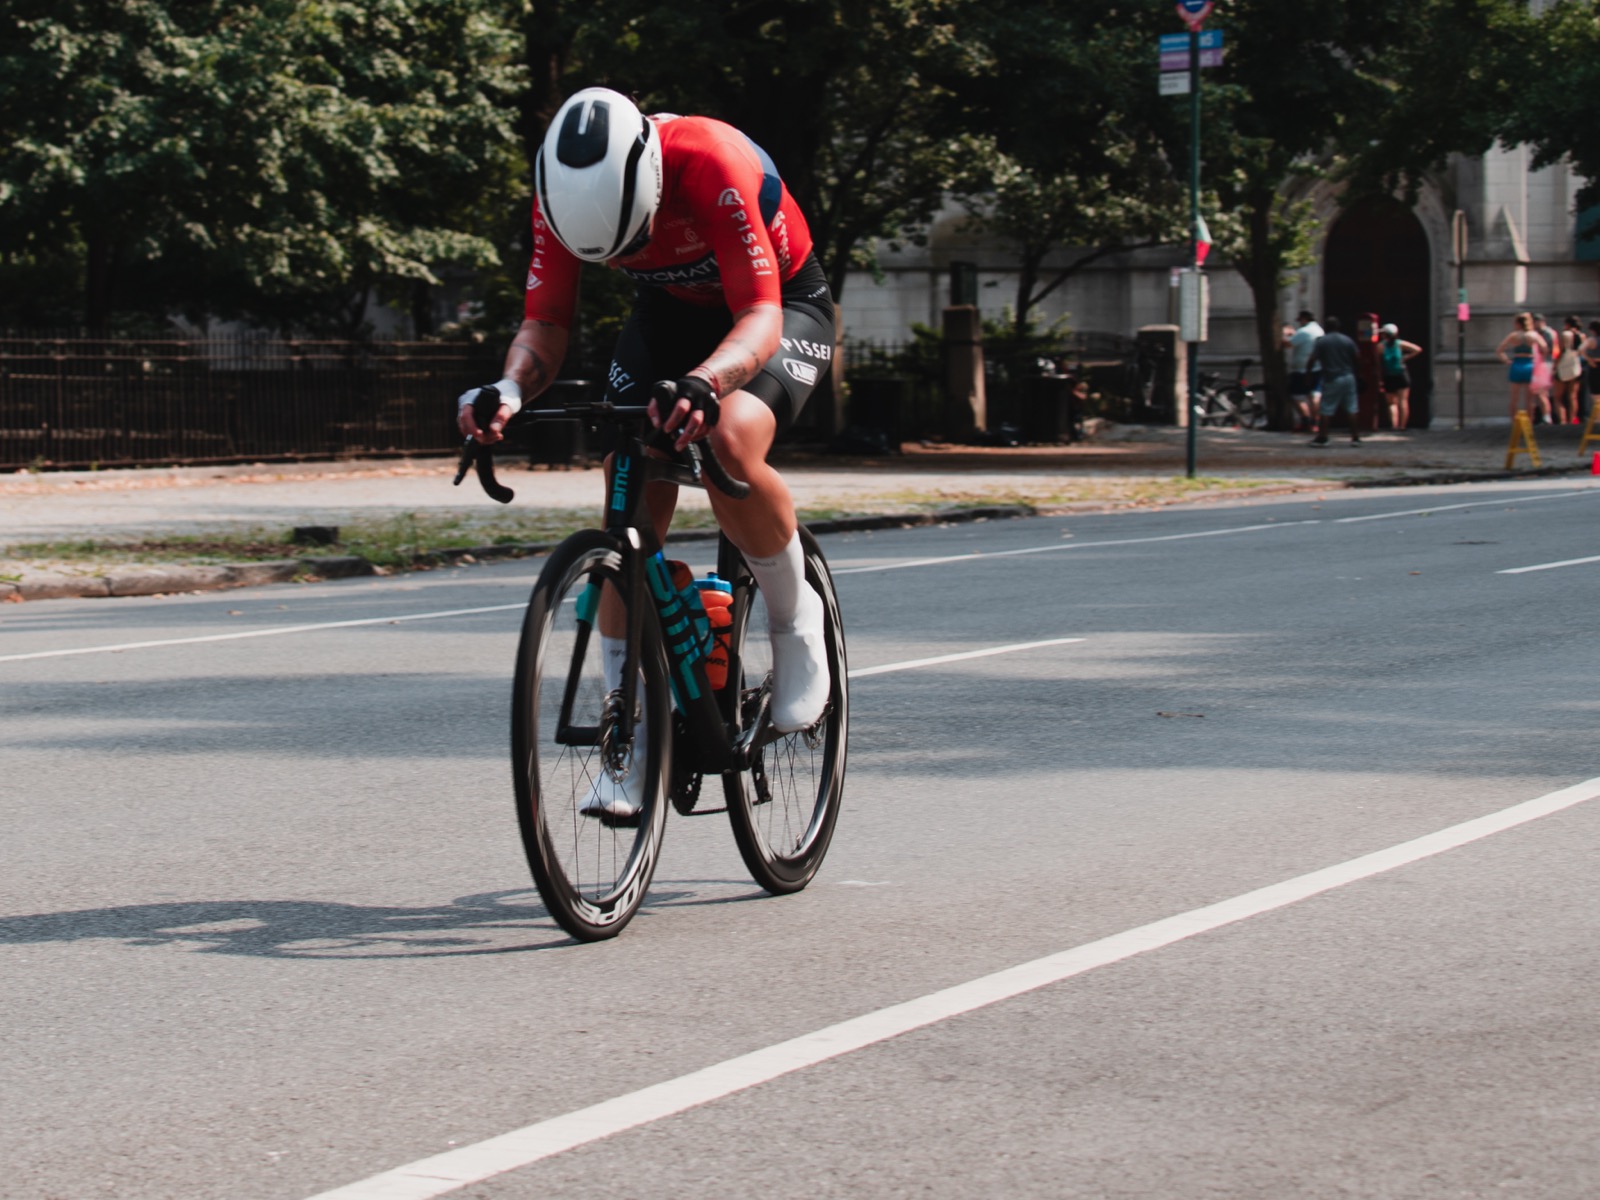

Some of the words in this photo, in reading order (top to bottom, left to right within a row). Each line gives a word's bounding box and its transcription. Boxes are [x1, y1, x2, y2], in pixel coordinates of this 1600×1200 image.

[730, 209, 774, 277] PISSEI
[621, 257, 719, 282] UTOMATI
[780, 337, 832, 361] PISSEI
[611, 454, 631, 512] BMC
